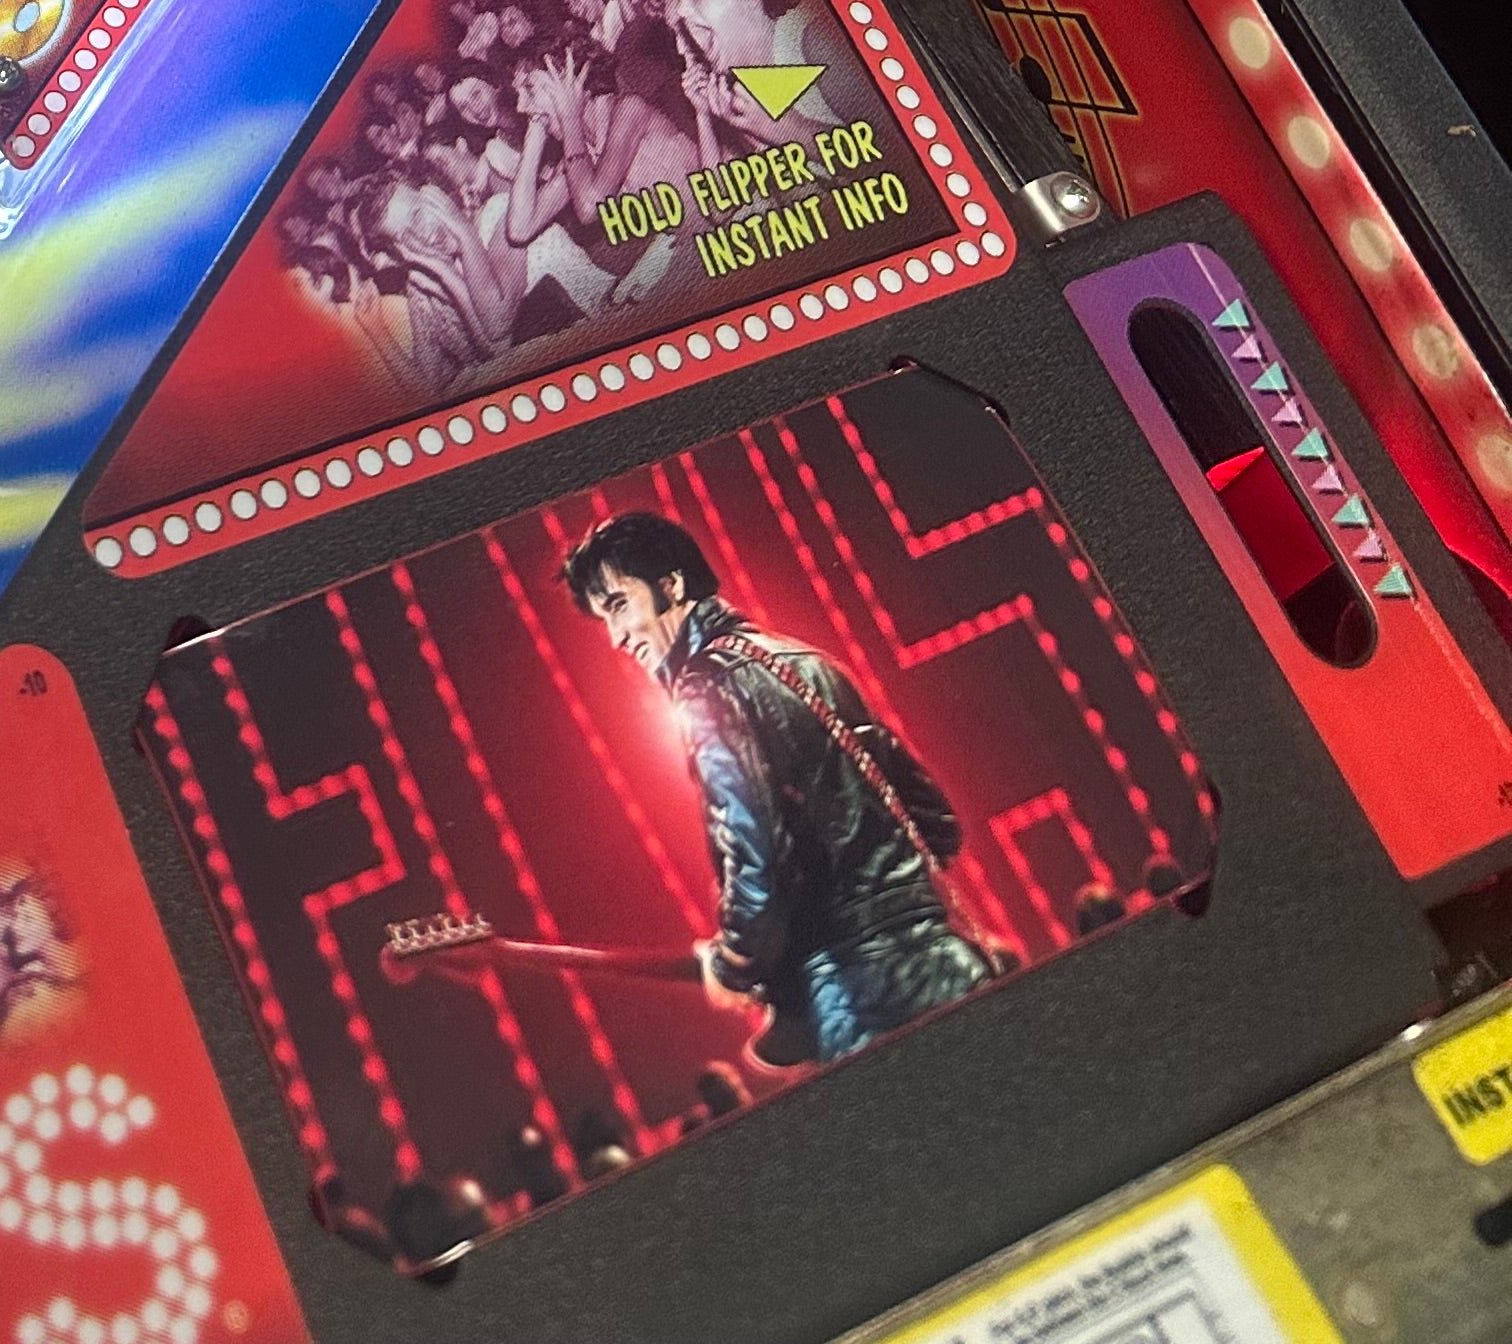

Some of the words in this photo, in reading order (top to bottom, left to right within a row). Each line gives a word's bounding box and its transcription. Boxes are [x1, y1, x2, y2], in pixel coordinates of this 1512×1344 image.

[597, 186, 683, 246] HOLD
[686, 149, 814, 218] FLIPPER
[816, 120, 883, 179] FOR
[694, 205, 828, 278] INSTANT
[835, 172, 910, 235] INFO
